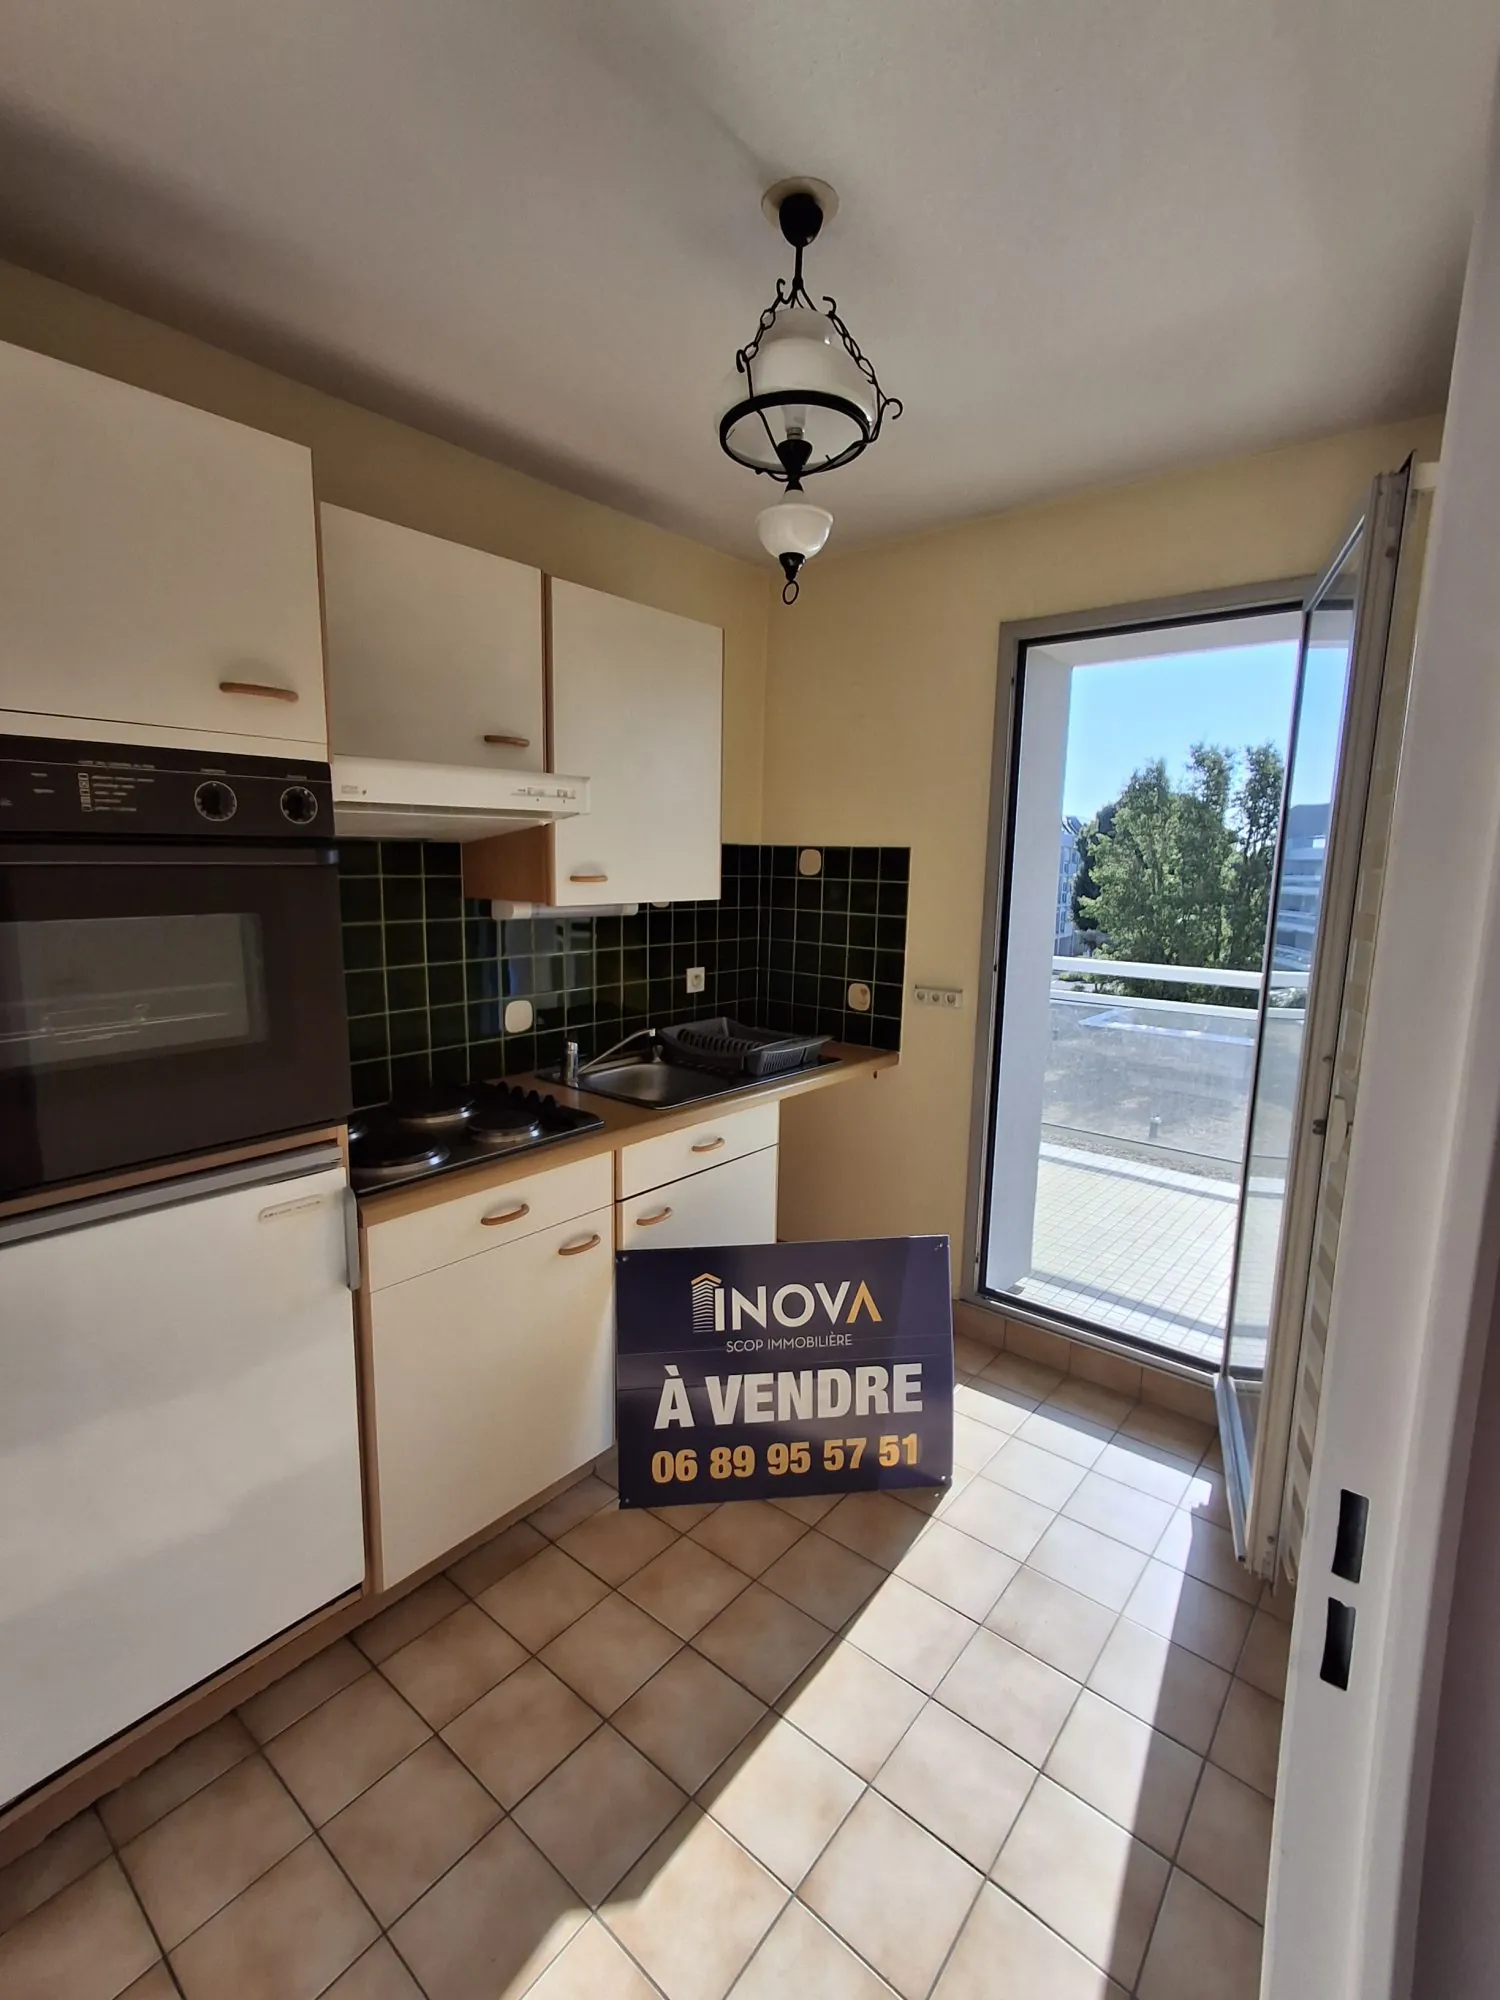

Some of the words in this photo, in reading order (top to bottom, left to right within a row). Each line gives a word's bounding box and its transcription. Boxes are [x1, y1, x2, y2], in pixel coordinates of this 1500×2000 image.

[714, 1280, 882, 1332] INOVA
[726, 1340, 764, 1353] SCOP
[767, 1332, 853, 1350] IMMOBILIÈRE
[654, 1364, 696, 1430] À
[704, 1362, 923, 1426] VENDRE
[652, 1449, 698, 1484] 06
[709, 1445, 756, 1480] 89
[767, 1442, 811, 1476] 95
[823, 1437, 867, 1471] 57
[878, 1433, 919, 1467] 51
